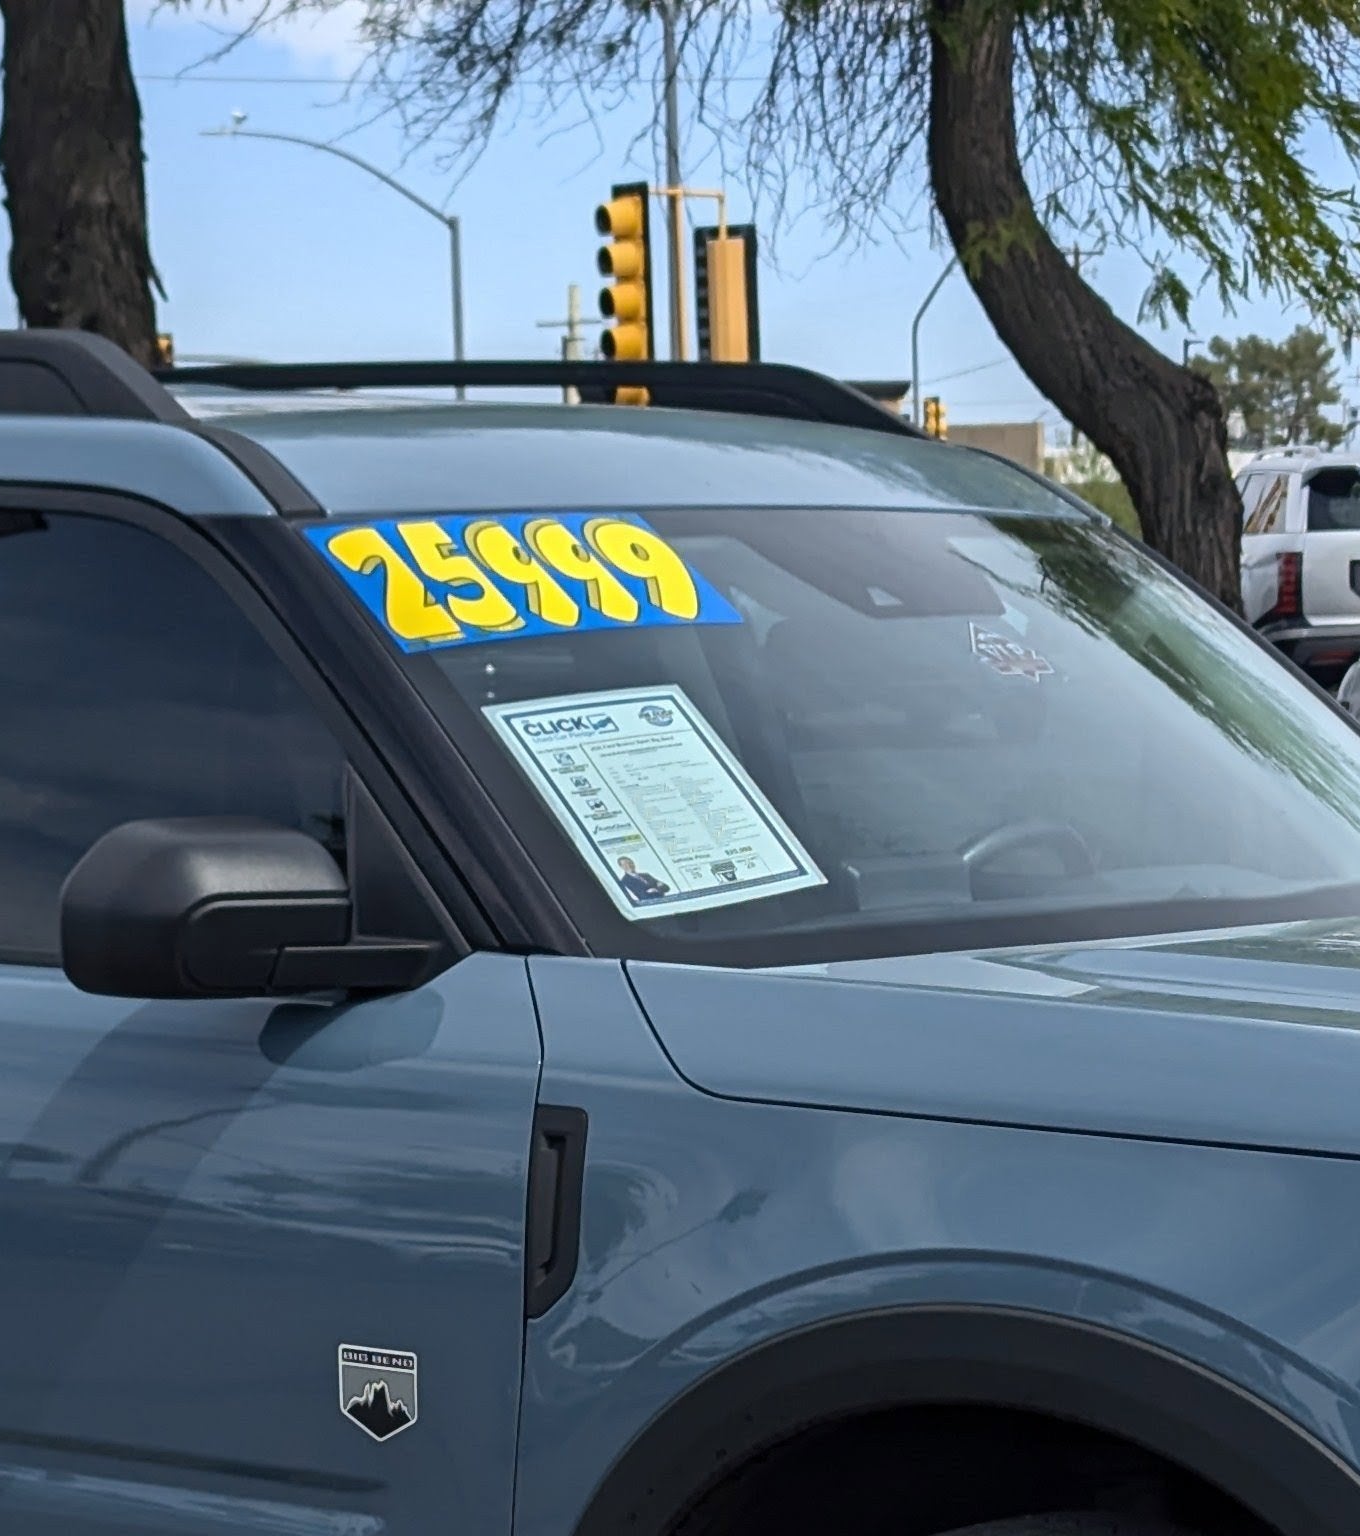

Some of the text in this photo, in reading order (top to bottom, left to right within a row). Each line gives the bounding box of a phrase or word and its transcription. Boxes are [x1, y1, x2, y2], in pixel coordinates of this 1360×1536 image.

[327, 517, 700, 643] 25999
[522, 715, 590, 737] CLICK
[371, 1354, 413, 1368] BEND
